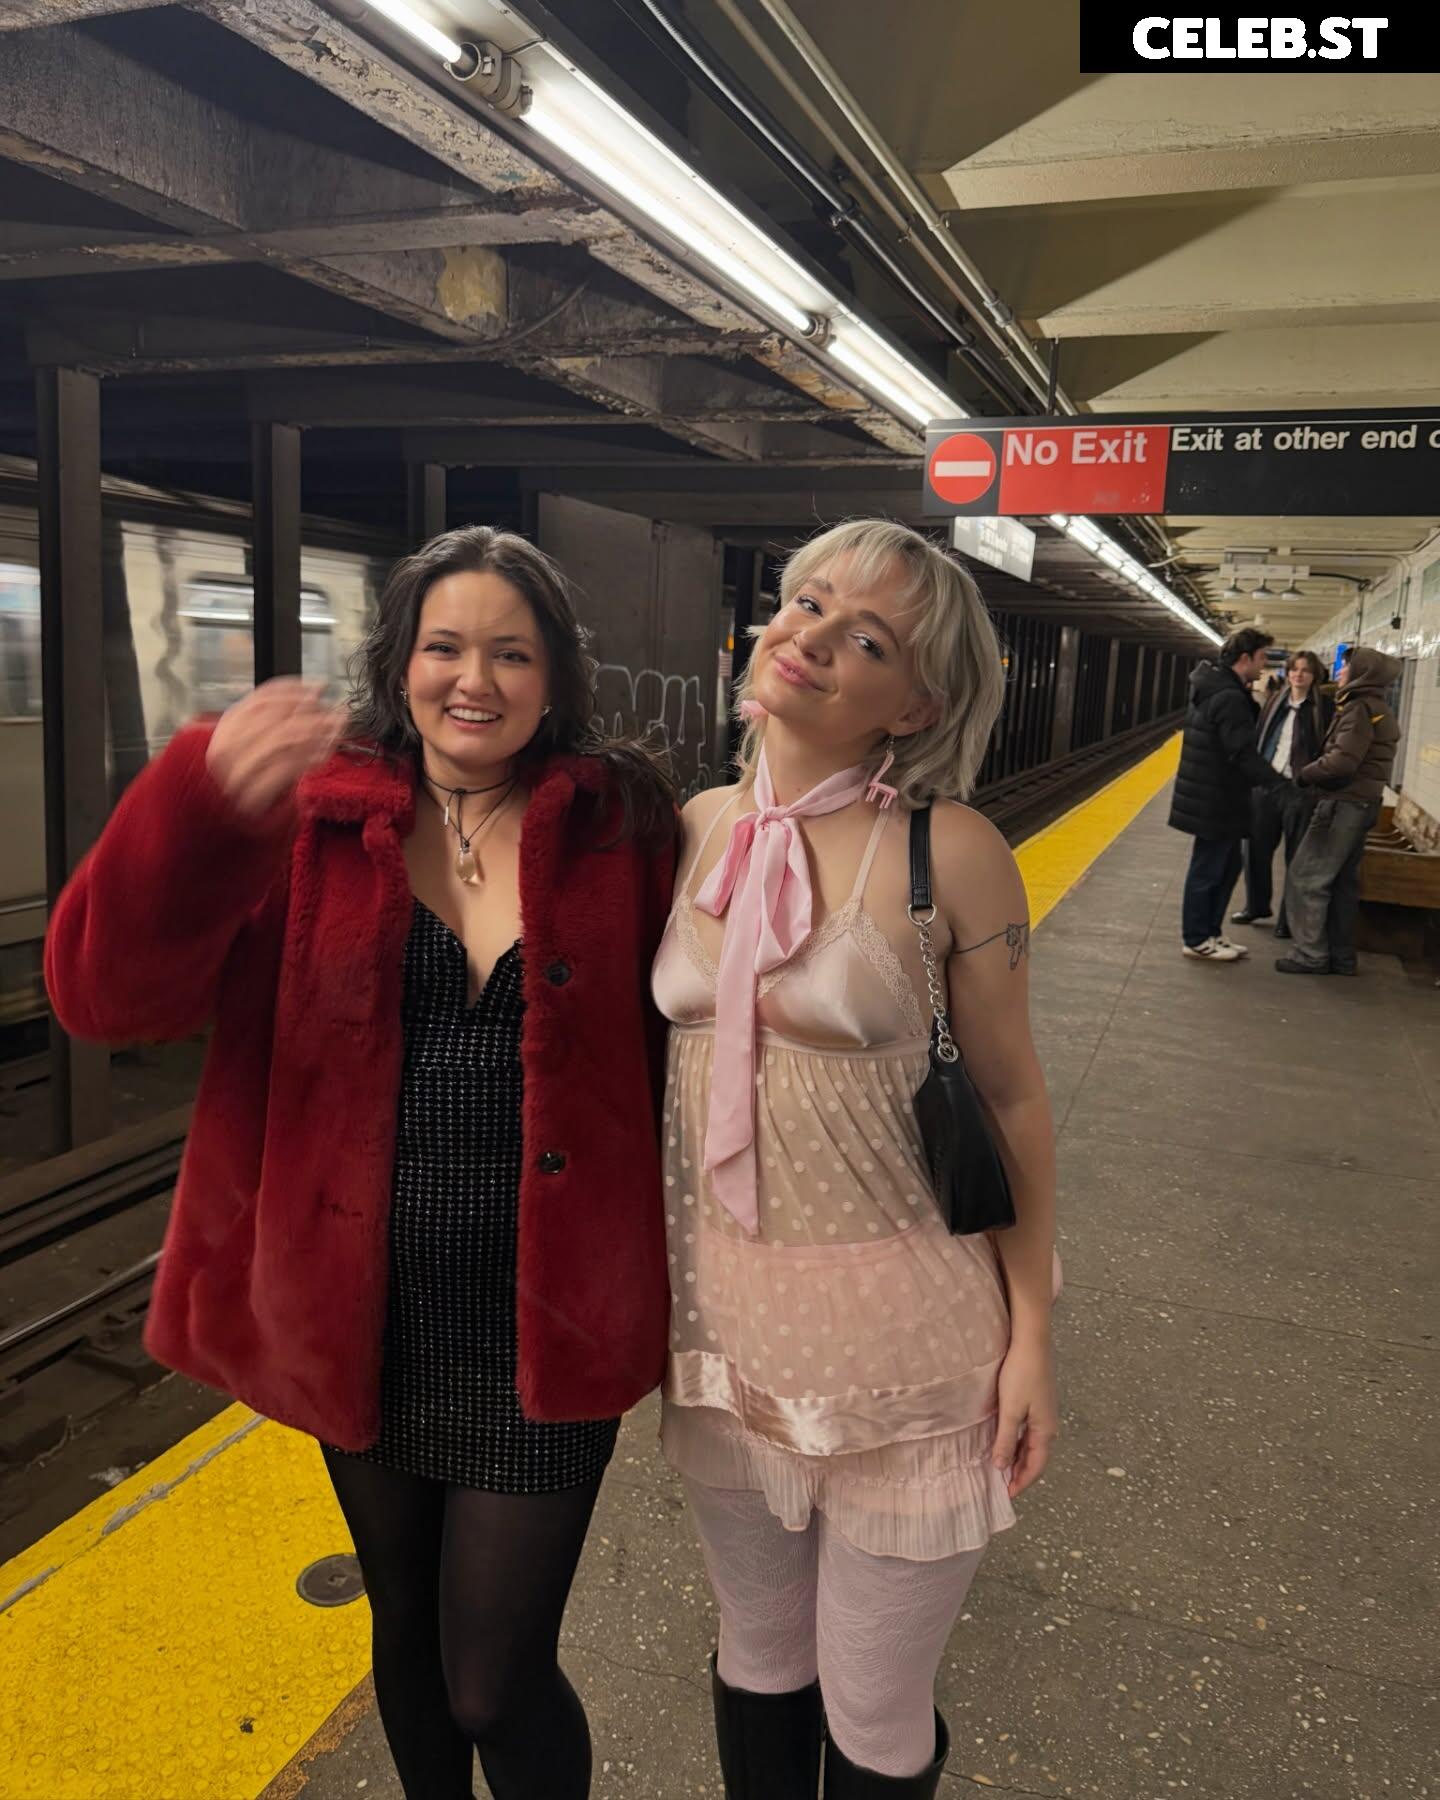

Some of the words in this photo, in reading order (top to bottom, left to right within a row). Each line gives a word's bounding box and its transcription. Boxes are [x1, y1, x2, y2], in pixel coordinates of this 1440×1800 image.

[1005, 433, 1059, 466] No
[1072, 430, 1148, 464] Exit
[1171, 427, 1224, 451] Exit
[1234, 428, 1263, 451] at
[1273, 426, 1350, 450] other
[1360, 424, 1418, 449] end
